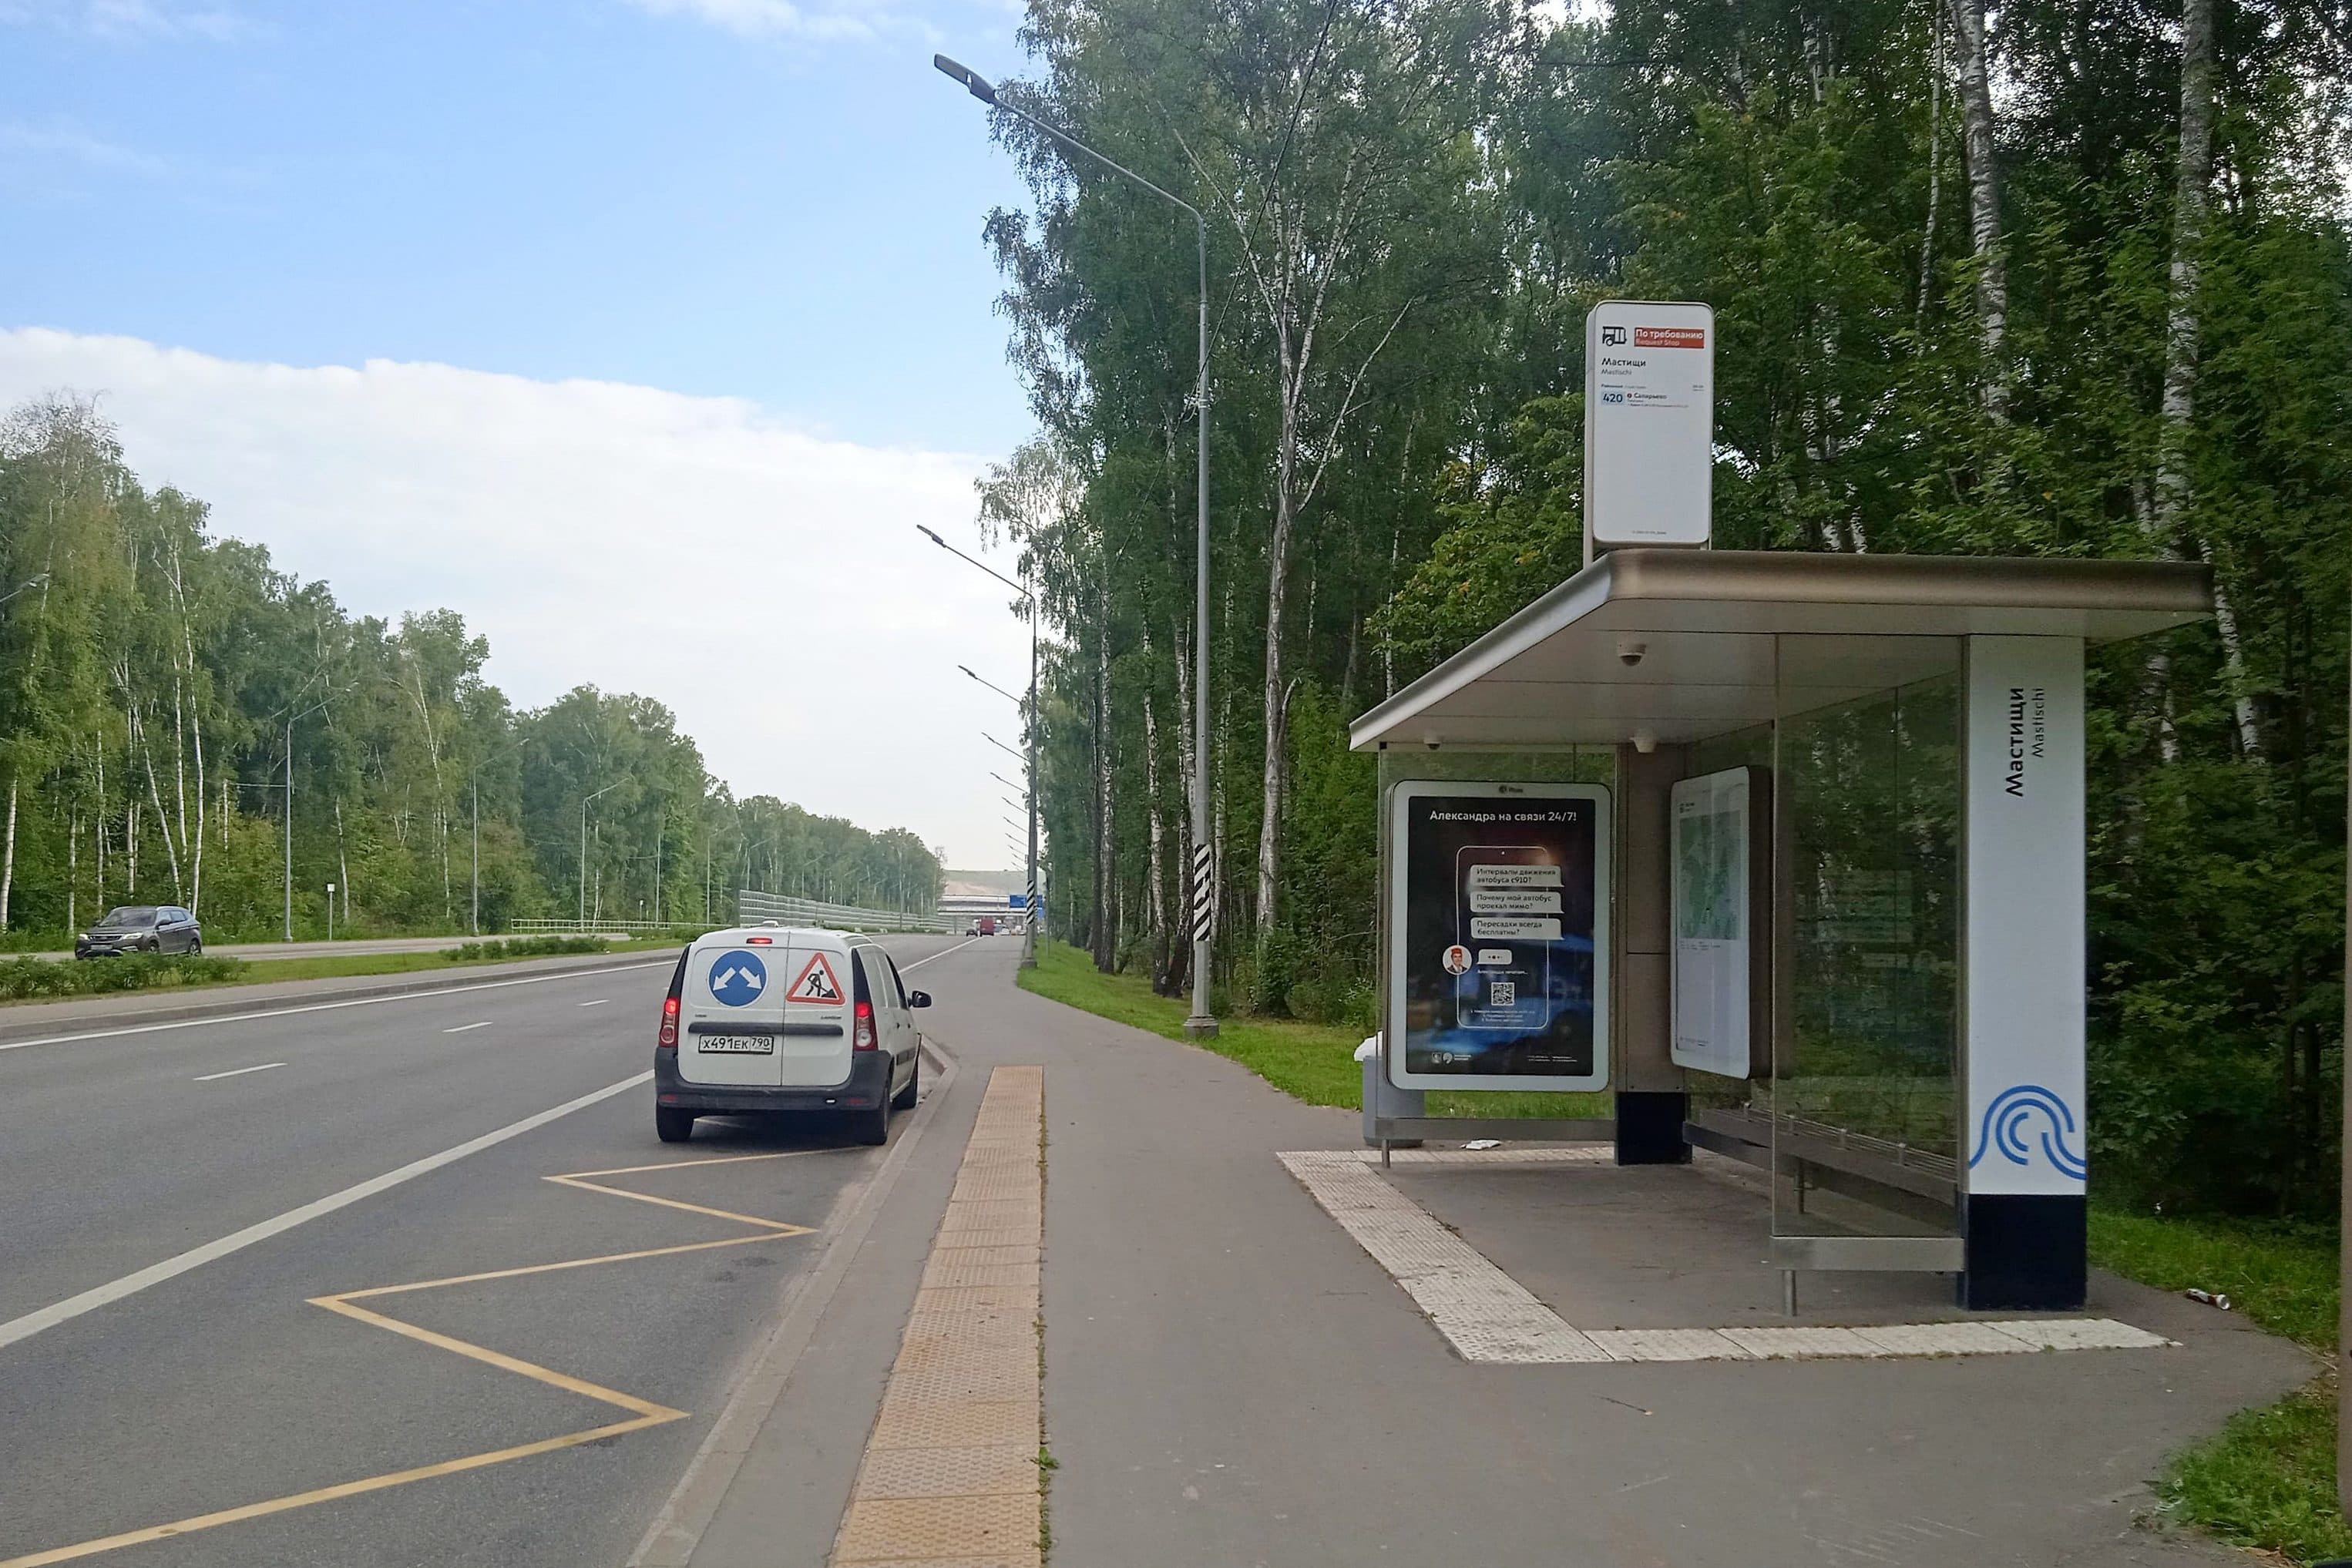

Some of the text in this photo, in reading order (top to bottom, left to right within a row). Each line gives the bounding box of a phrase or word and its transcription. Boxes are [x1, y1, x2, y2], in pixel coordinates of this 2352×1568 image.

[1635, 329, 1704, 339] По требованию
[1601, 358, 1646, 367] Мастищи
[1603, 393, 1623, 402] 420
[2031, 688, 2044, 757] Mastischi
[2005, 688, 2026, 797] Мастищи
[1430, 811, 1496, 823] Александра
[1548, 811, 1578, 822] 24/7!
[1477, 894, 1505, 902] Почему
[751, 1037, 770, 1047] 790
